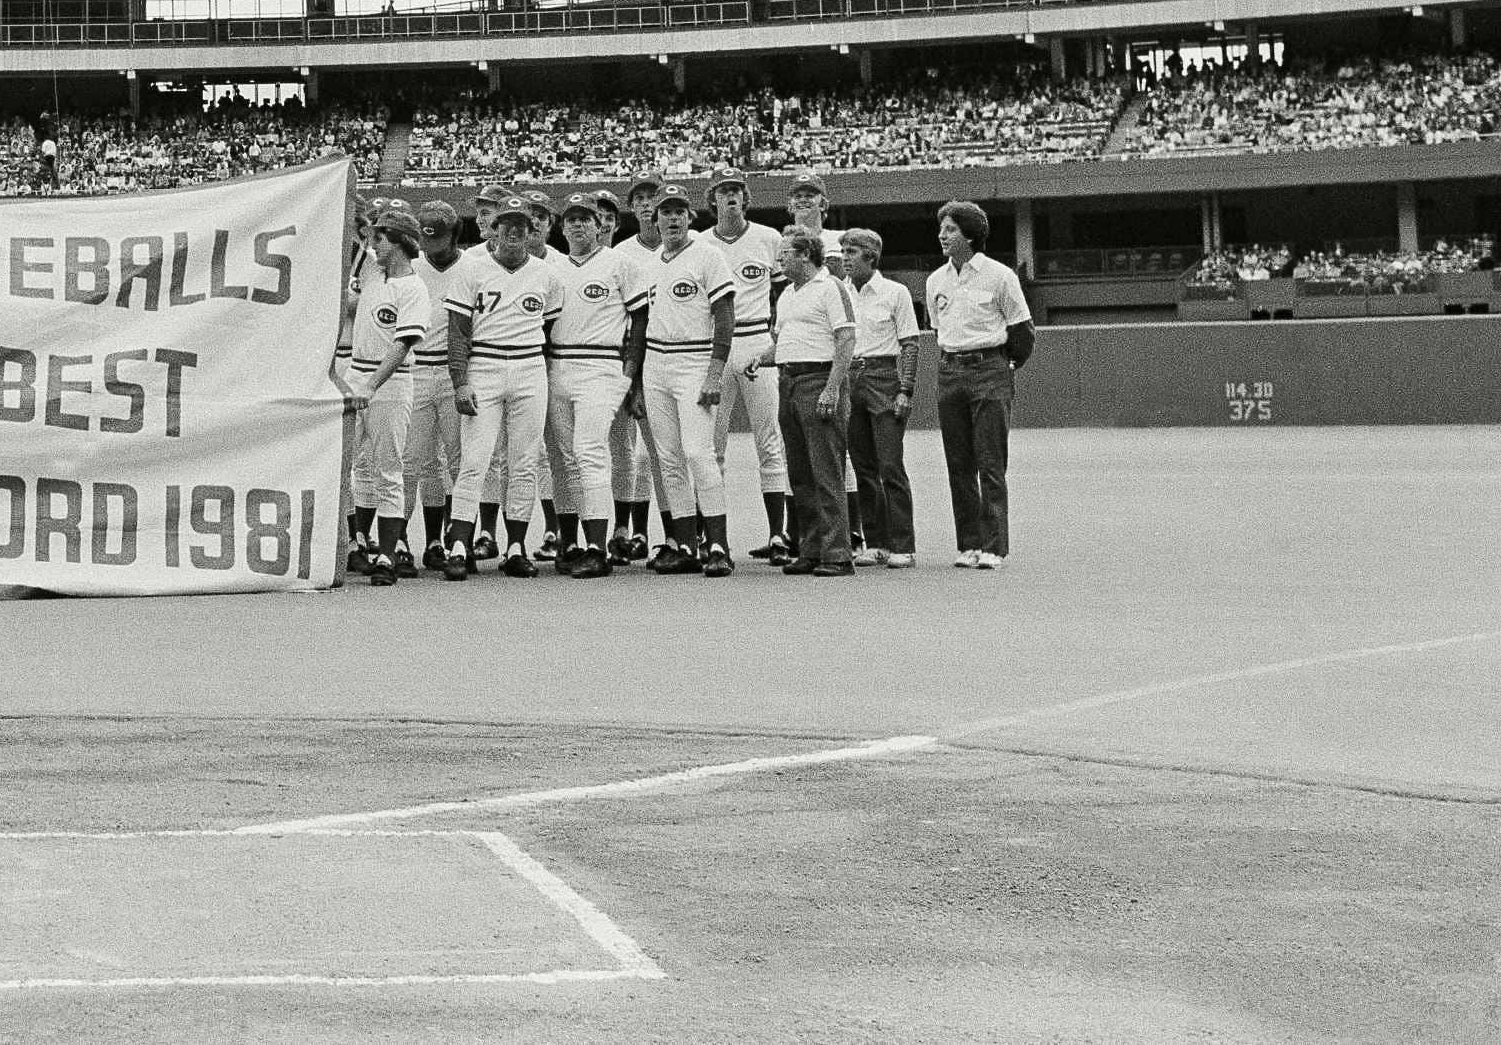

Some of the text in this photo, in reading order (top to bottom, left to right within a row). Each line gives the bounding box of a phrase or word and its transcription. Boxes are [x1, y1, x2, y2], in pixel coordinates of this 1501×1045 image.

[476, 290, 502, 314] 47
[1225, 381, 1273, 398] 114.30
[1229, 400, 1271, 421] 375
[164, 483, 316, 580] 1981
